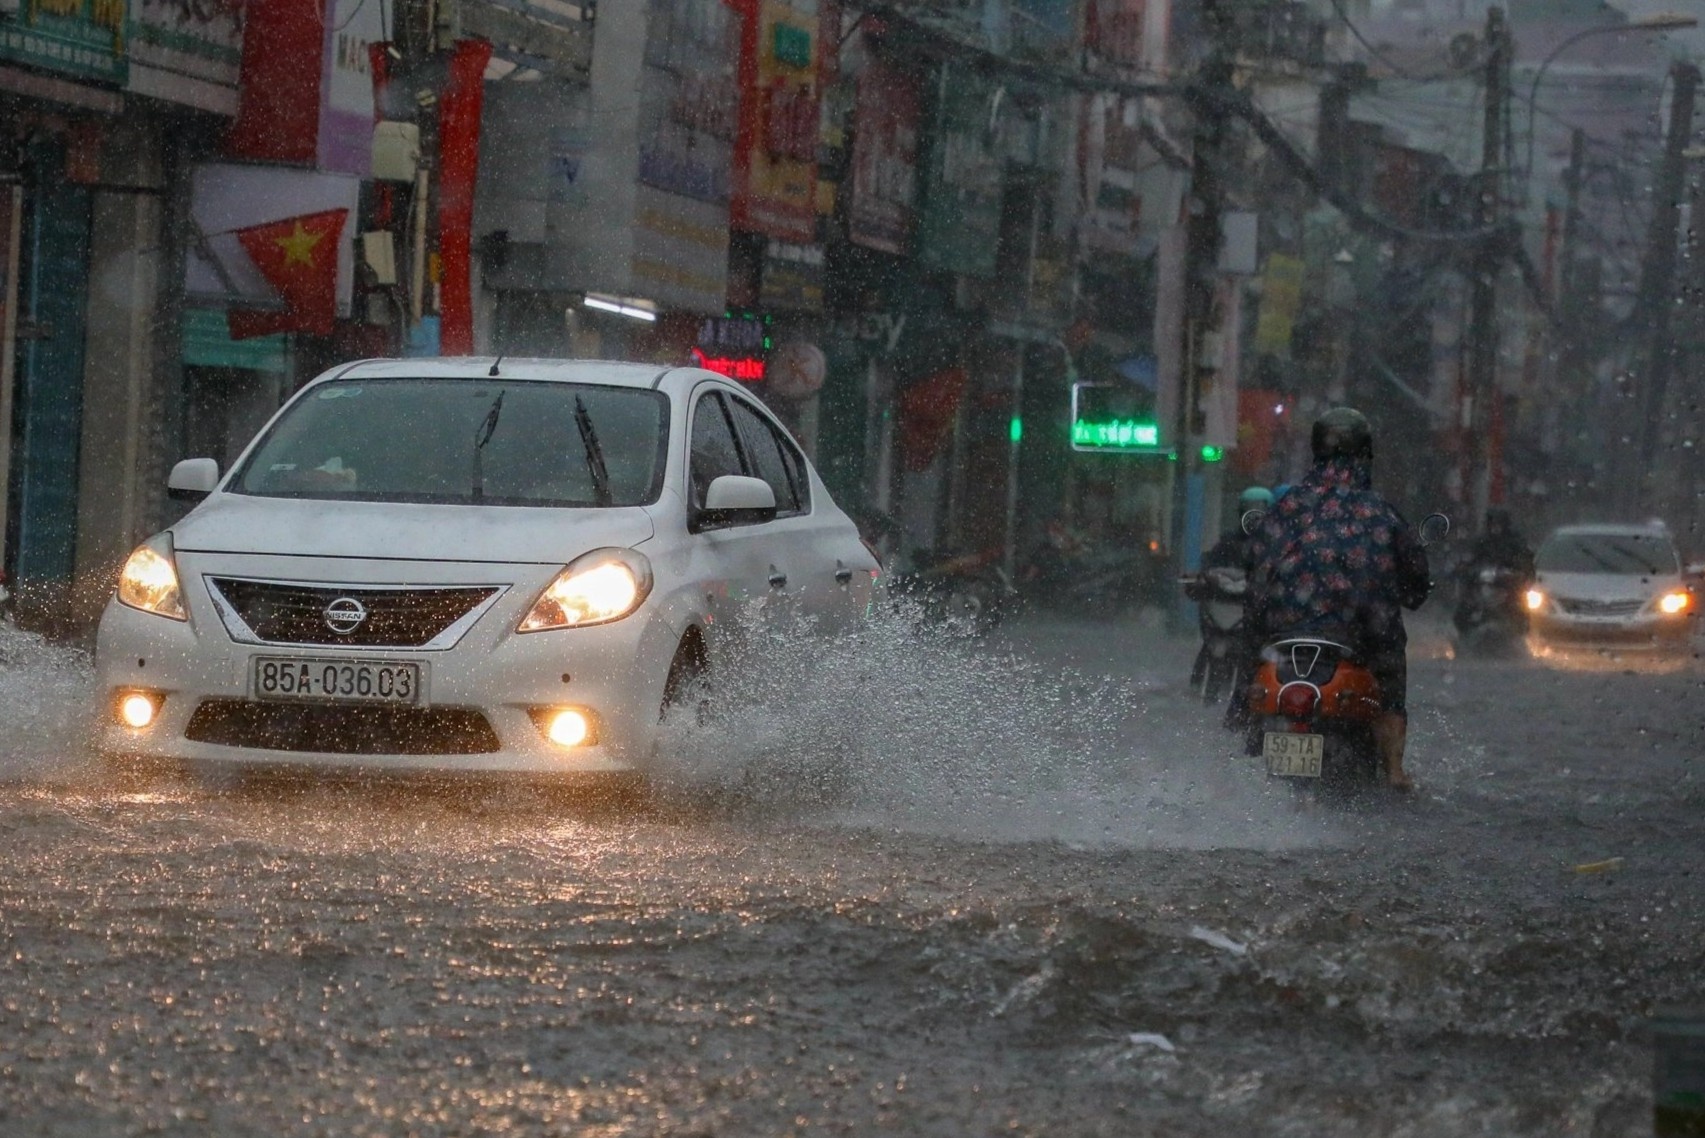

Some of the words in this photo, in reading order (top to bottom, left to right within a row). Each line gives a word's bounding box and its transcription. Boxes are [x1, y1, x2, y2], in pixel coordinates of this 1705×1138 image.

[325, 611, 362, 621] NISSAN
[262, 662, 411, 698] 85A-036.03
[1272, 737, 1314, 754] 59-TA
